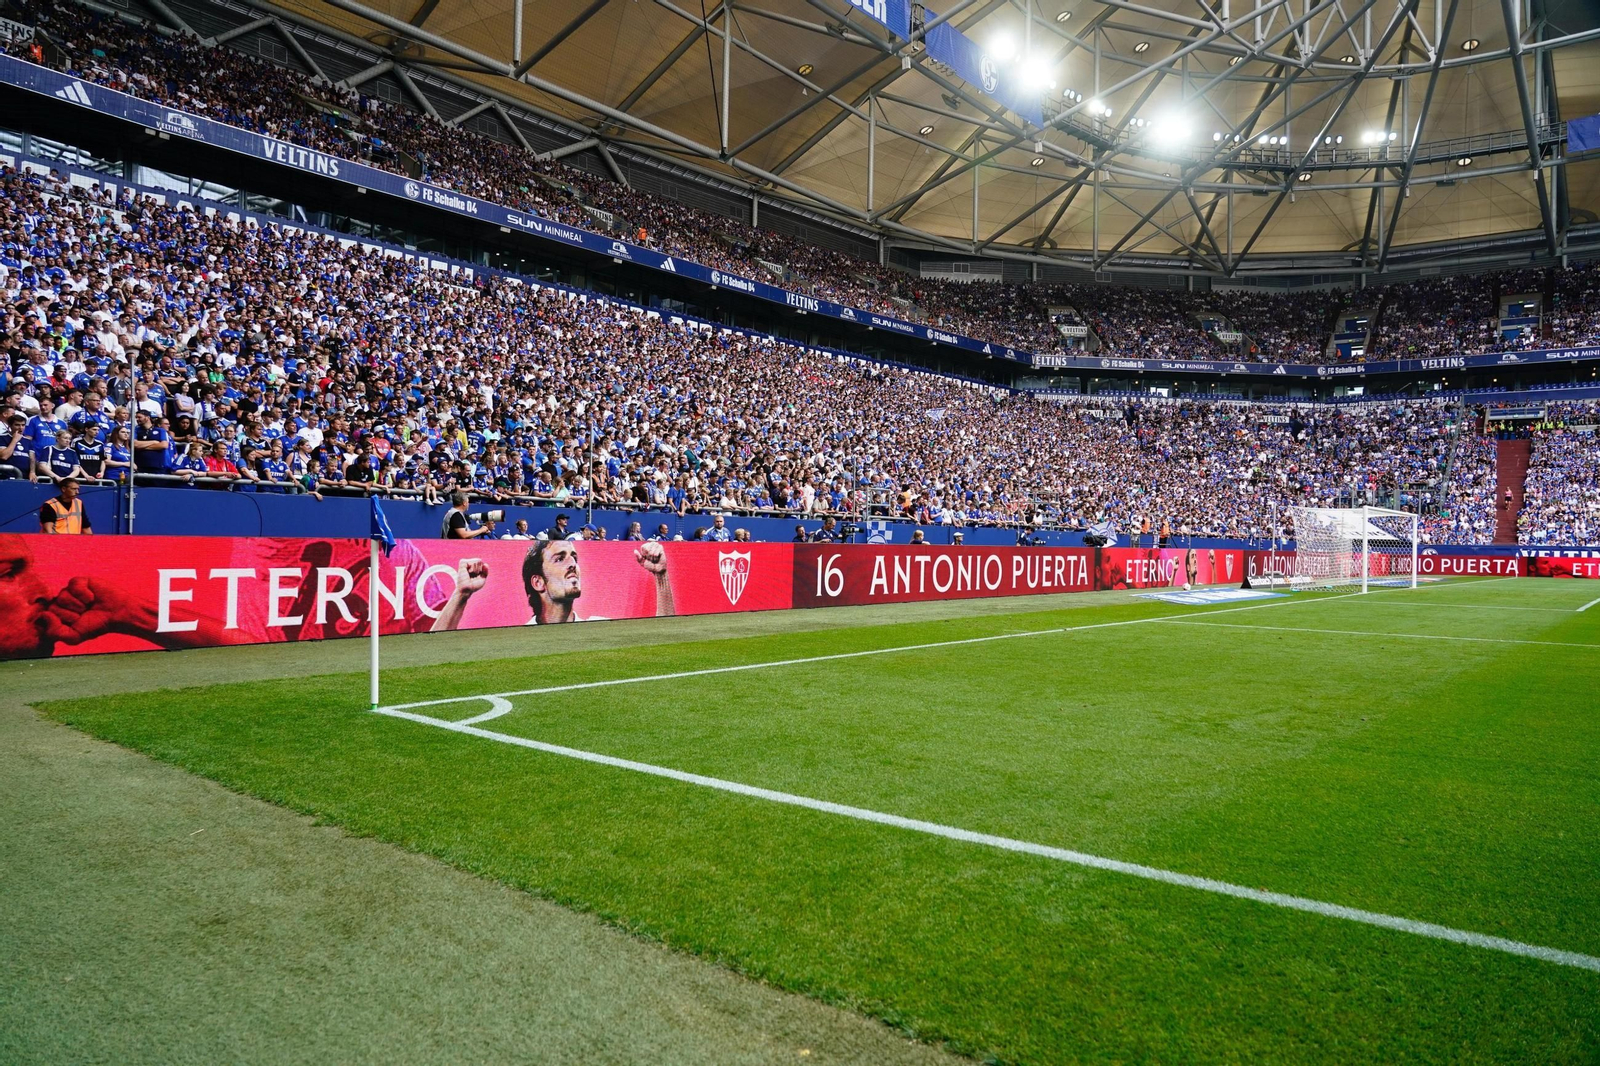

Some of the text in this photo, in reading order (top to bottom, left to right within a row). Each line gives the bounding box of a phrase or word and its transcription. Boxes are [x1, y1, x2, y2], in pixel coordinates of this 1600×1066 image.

[0, 20, 33, 40] TINS
[262, 138, 340, 177] VELTINS
[422, 187, 478, 214] FC Schalke 04
[507, 214, 583, 243] SUN MINIMEAL
[721, 274, 729, 285] FC
[785, 292, 819, 311] VELTINS
[871, 316, 915, 333] SUN MINIMEAL
[1031, 355, 1067, 366] VELTINS
[1111, 359, 1118, 367] FC
[1421, 357, 1465, 369] VELTINS
[1546, 351, 1579, 359] SUN
[1327, 366, 1334, 374] FC
[1335, 366, 1356, 374] Schalke
[1126, 559, 1174, 583] ETERNO
[1248, 554, 1257, 577] 16
[1441, 558, 1518, 574] PUERTA
[1572, 562, 1600, 576] ET
[815, 553, 1089, 597] 16 ANTONIO PUERTA
[155, 565, 460, 634] ETERNO
